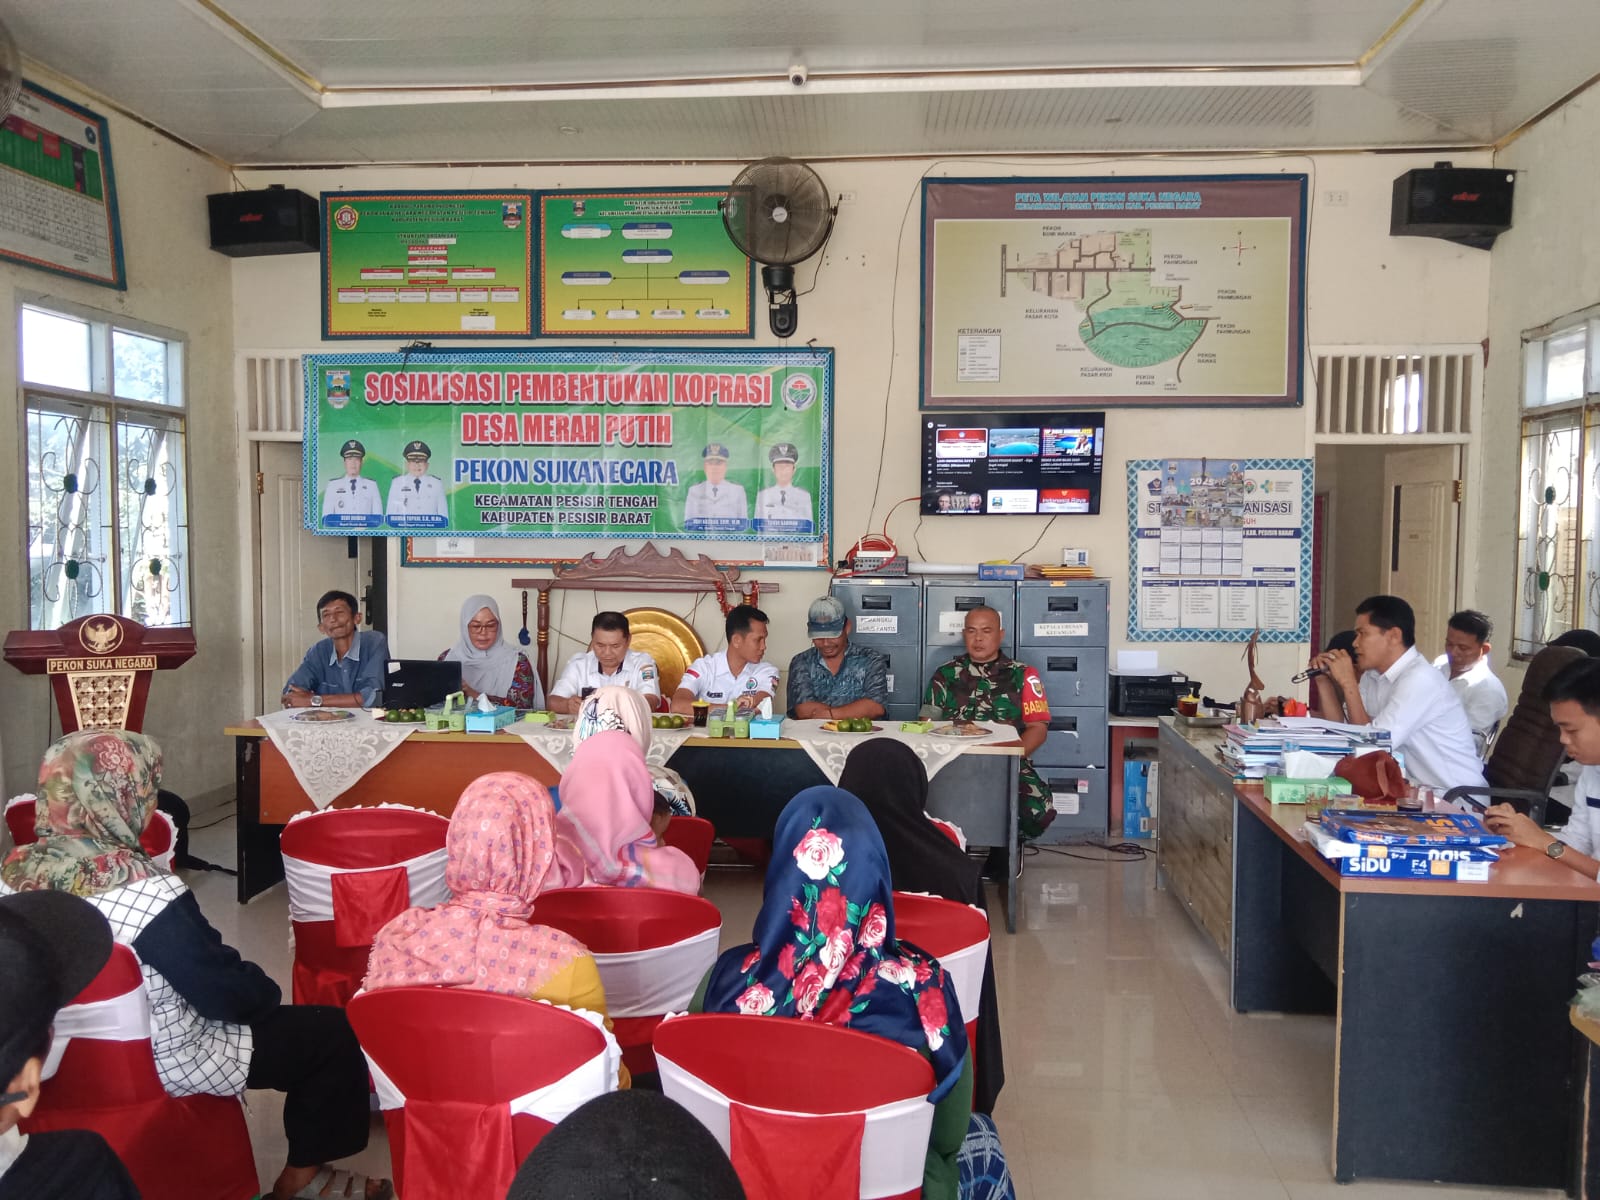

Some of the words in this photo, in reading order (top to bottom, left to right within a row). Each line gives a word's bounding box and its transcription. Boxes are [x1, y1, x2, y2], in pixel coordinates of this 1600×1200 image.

[1015, 192, 1040, 202] PETA
[365, 372, 501, 403] SOSIALISASI
[504, 372, 670, 404] PEMBENTUKAN
[673, 372, 773, 405] KOPRASI
[461, 413, 519, 445] DESA
[522, 413, 601, 445] MERAH
[605, 413, 673, 446] PUTIH
[454, 458, 528, 485] PEKON
[532, 459, 679, 485] SUKANEGARA
[474, 494, 553, 508] KECAMATAN
[556, 495, 605, 508] PESISIR
[608, 495, 658, 508] TENGAH
[1243, 502, 1292, 514] ANISASI
[480, 511, 555, 524] KABUPATEN
[557, 511, 607, 524] PESISIR
[610, 511, 652, 524] BARAT
[50, 660, 84, 671] PEKON
[86, 659, 113, 670] SUKA
[115, 657, 154, 669] NEGARA
[1349, 857, 1391, 873] SiDU
[1411, 859, 1427, 869] F4
